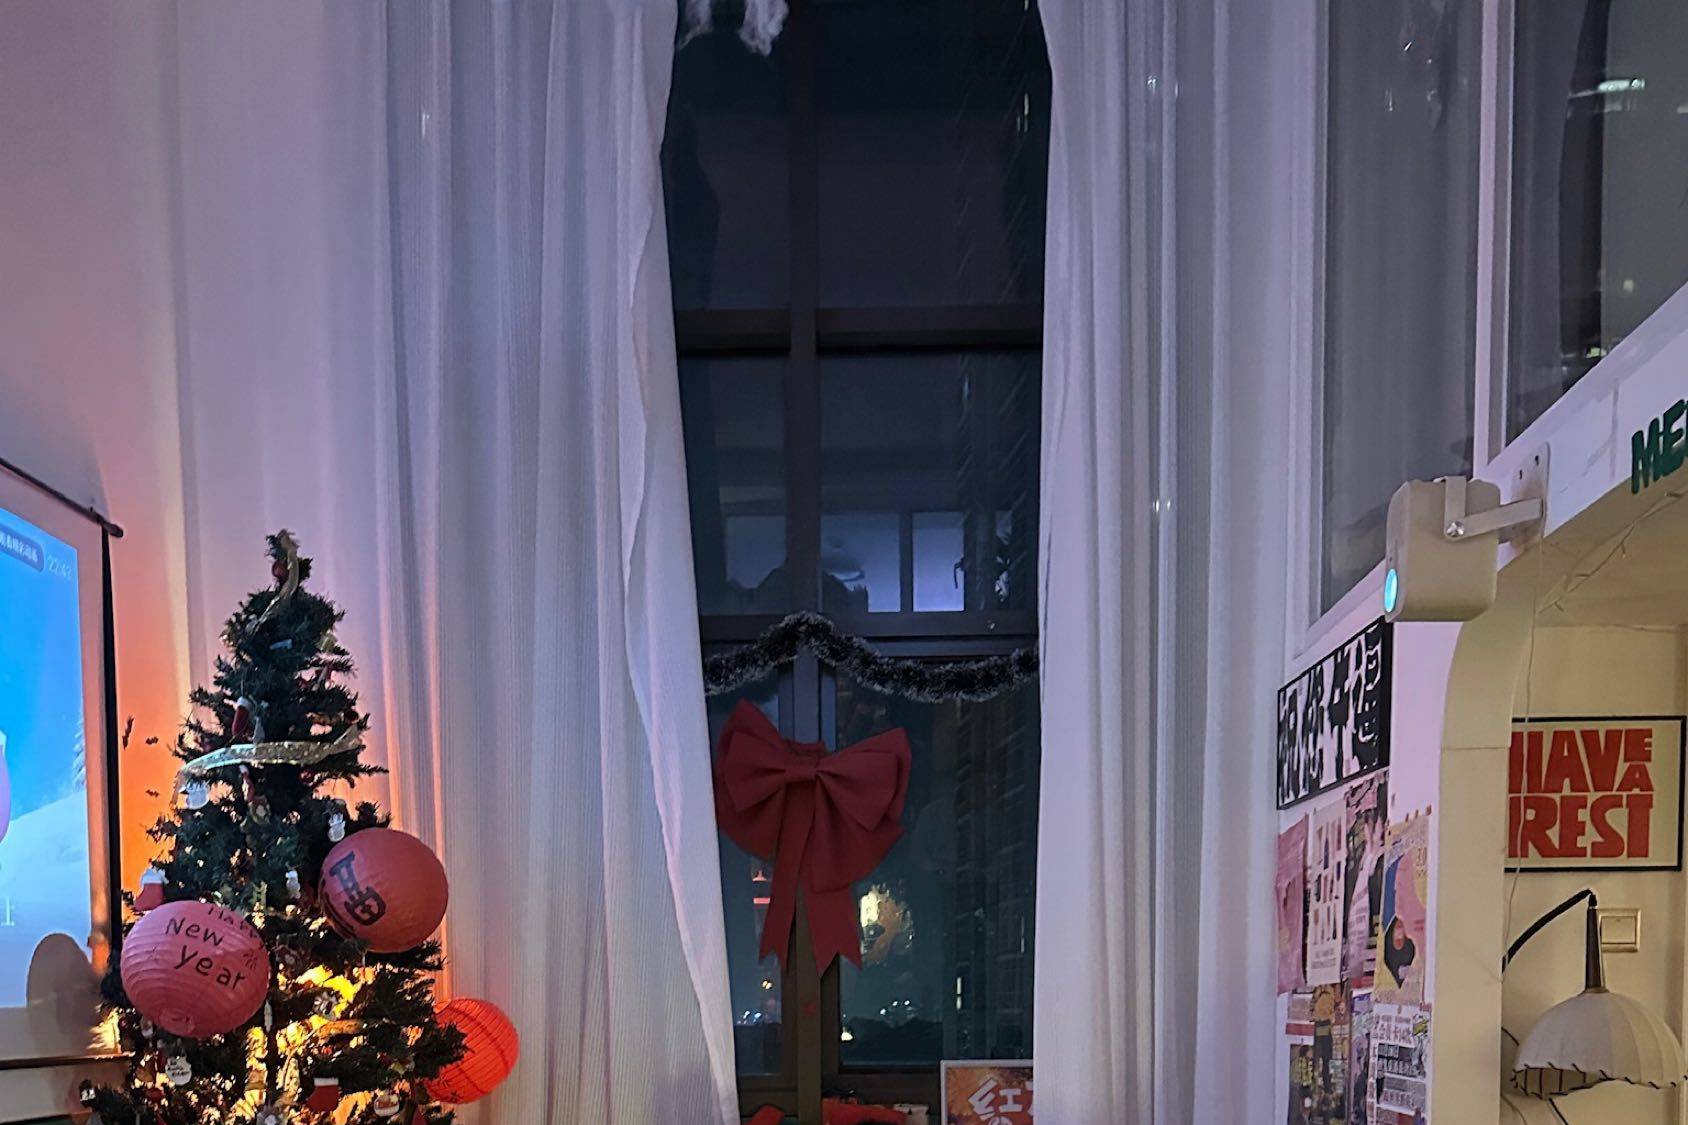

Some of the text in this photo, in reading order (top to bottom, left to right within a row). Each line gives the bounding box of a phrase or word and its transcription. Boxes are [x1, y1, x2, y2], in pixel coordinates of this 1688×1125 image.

[1631, 399, 1688, 495] ME
[1509, 728, 1653, 793] HAVE
[1616, 763, 1654, 792] A
[1508, 794, 1653, 858] REST
[165, 917, 224, 947] New
